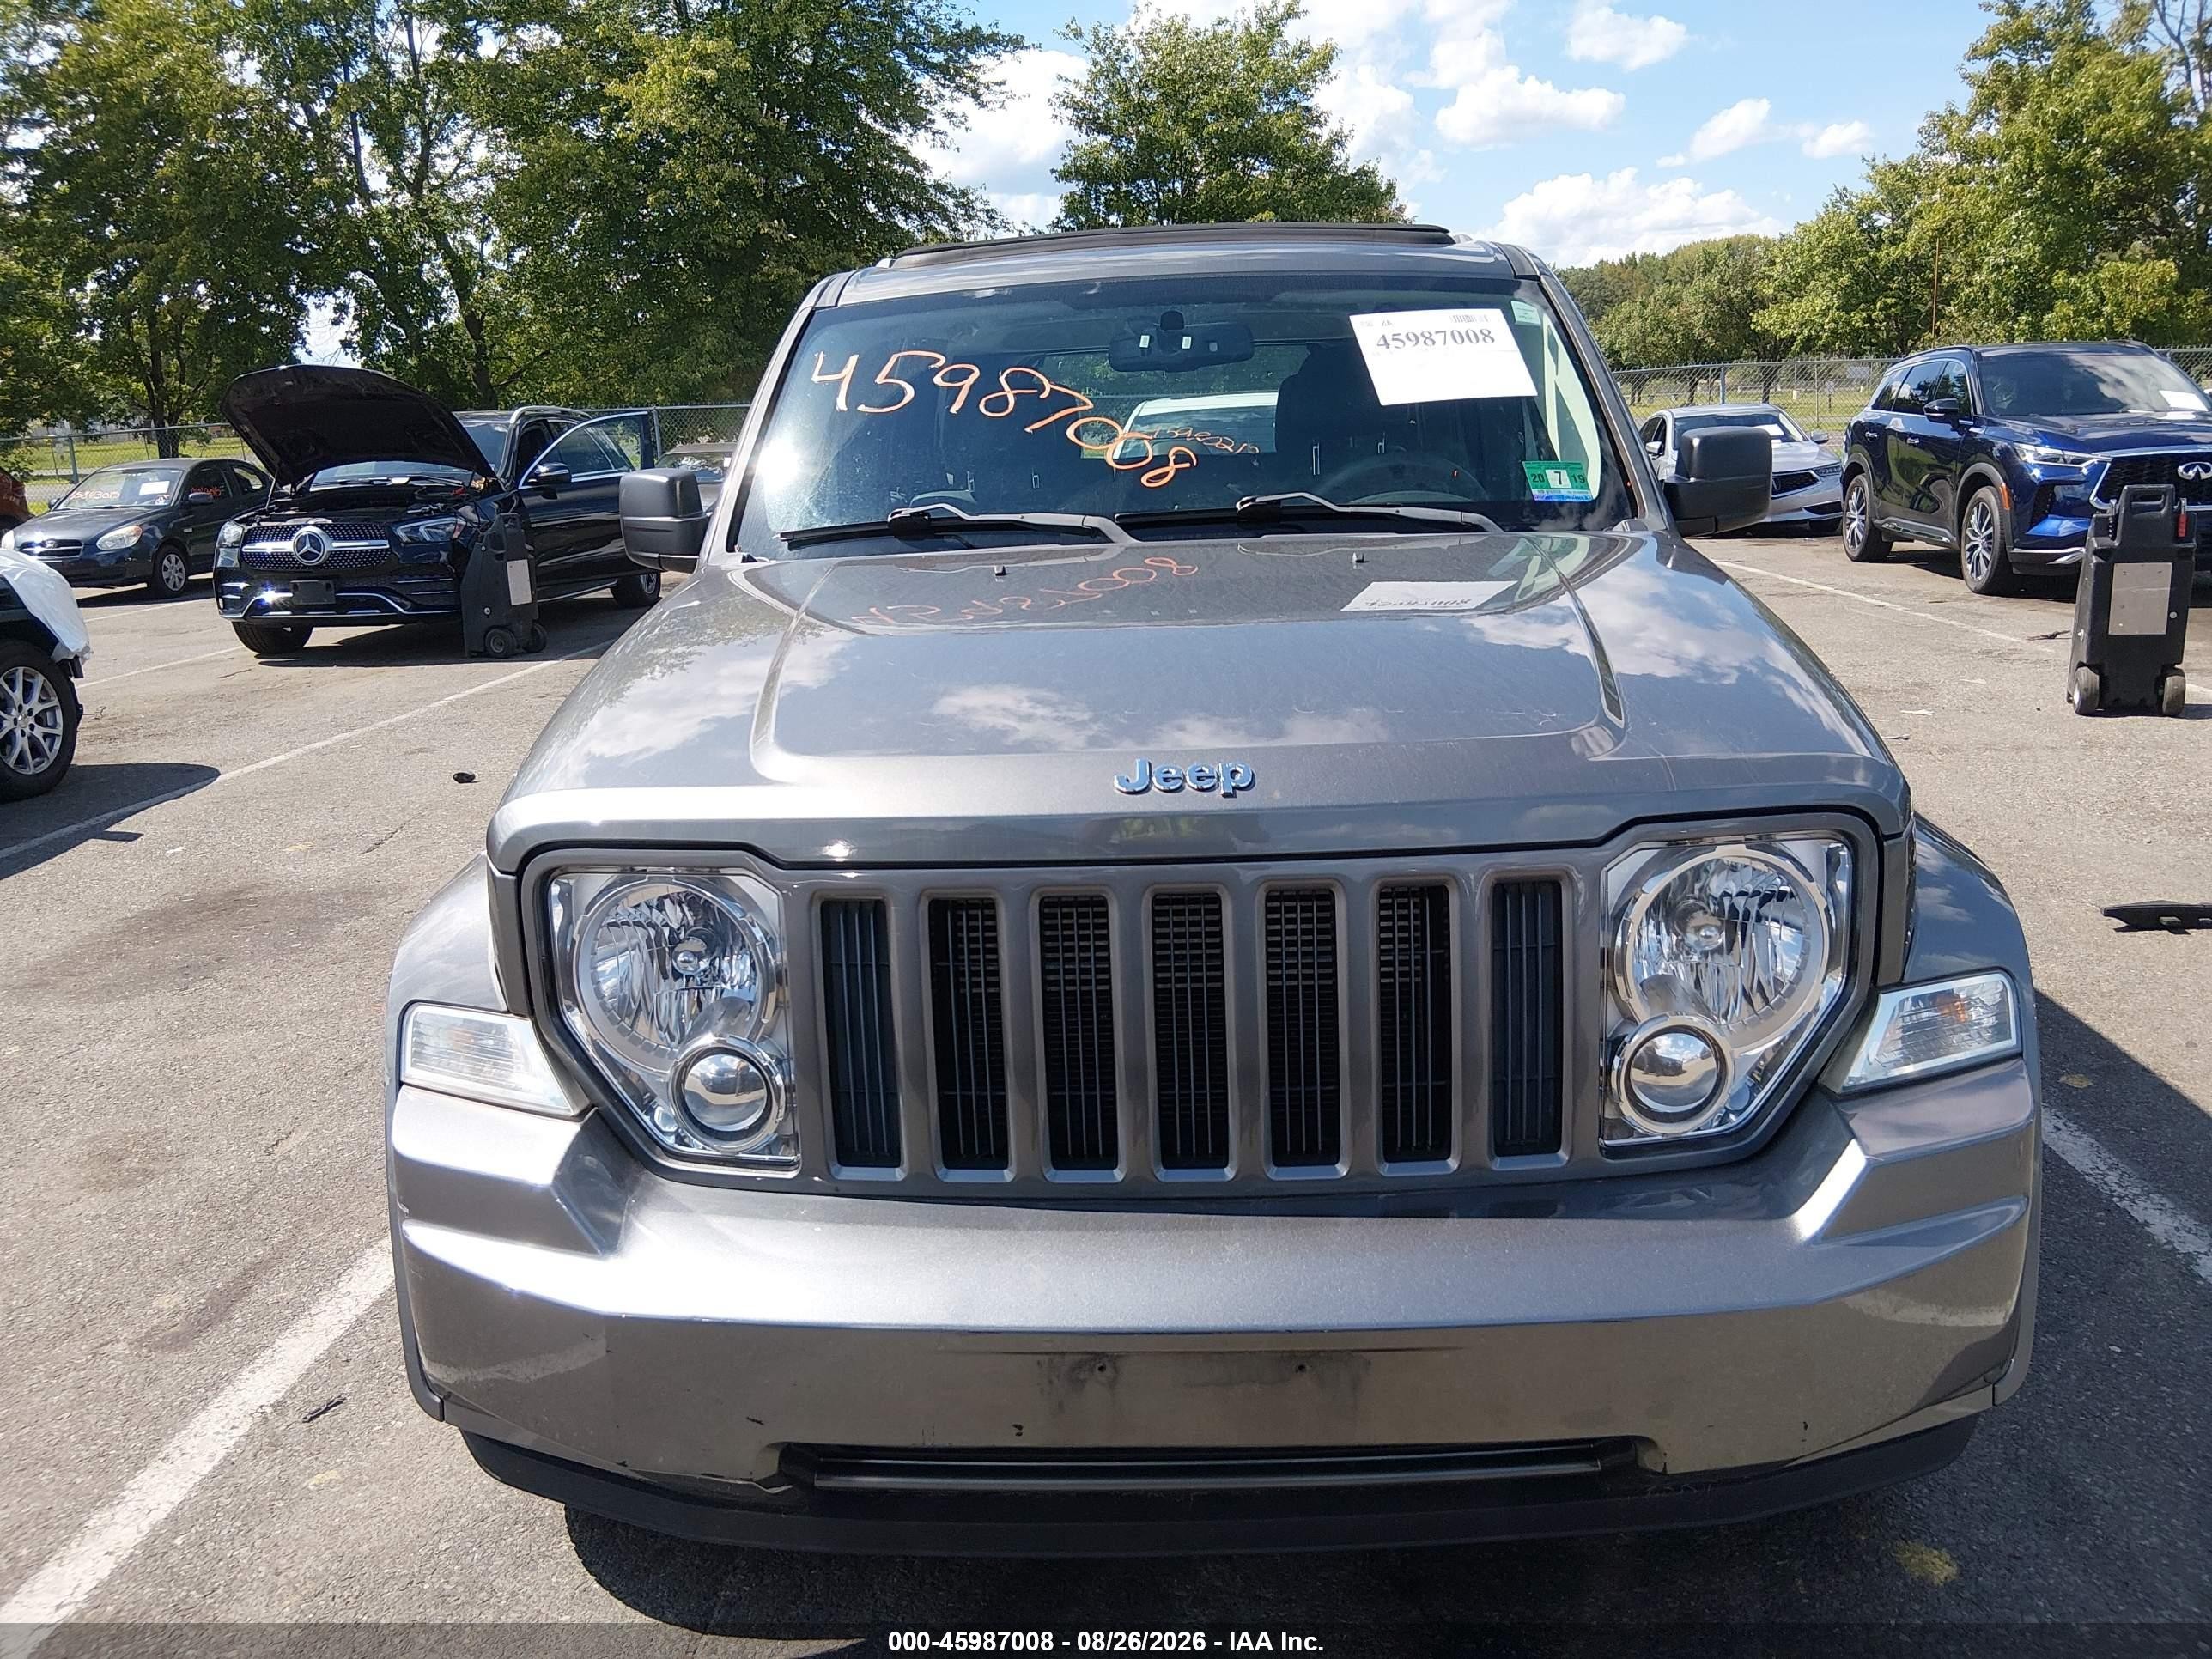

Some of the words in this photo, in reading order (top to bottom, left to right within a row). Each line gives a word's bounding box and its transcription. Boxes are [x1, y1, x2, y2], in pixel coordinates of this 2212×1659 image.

[1376, 328, 1496, 349] 45987008
[811, 350, 1198, 488] 45987008
[1531, 473, 1545, 483] 20
[1554, 471, 1562, 485] 7
[1571, 473, 1585, 483] 19
[1114, 758, 1256, 798] Jeep
